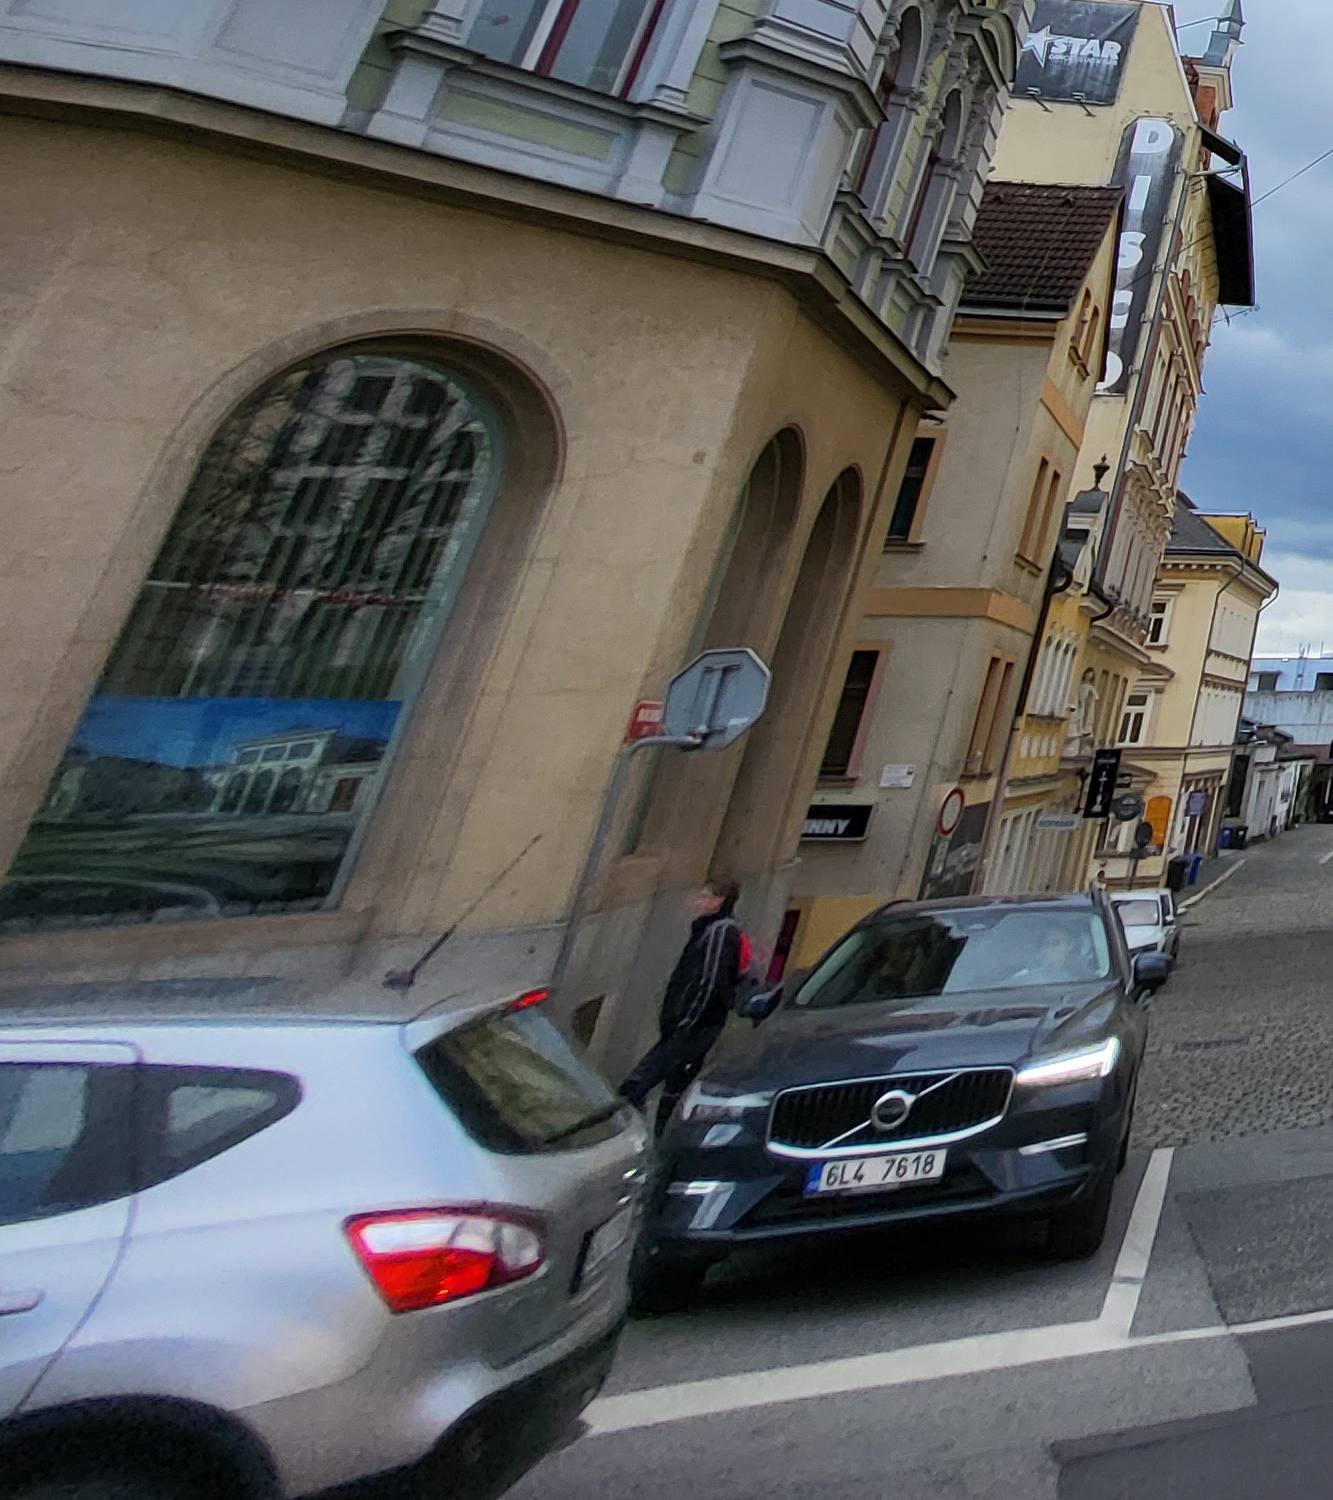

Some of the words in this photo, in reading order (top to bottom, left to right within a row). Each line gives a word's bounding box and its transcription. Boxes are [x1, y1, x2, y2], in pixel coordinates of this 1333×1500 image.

[1050, 36, 1122, 60] STAR
[826, 1162, 865, 1186] 6L4
[882, 1153, 935, 1181] 7618
